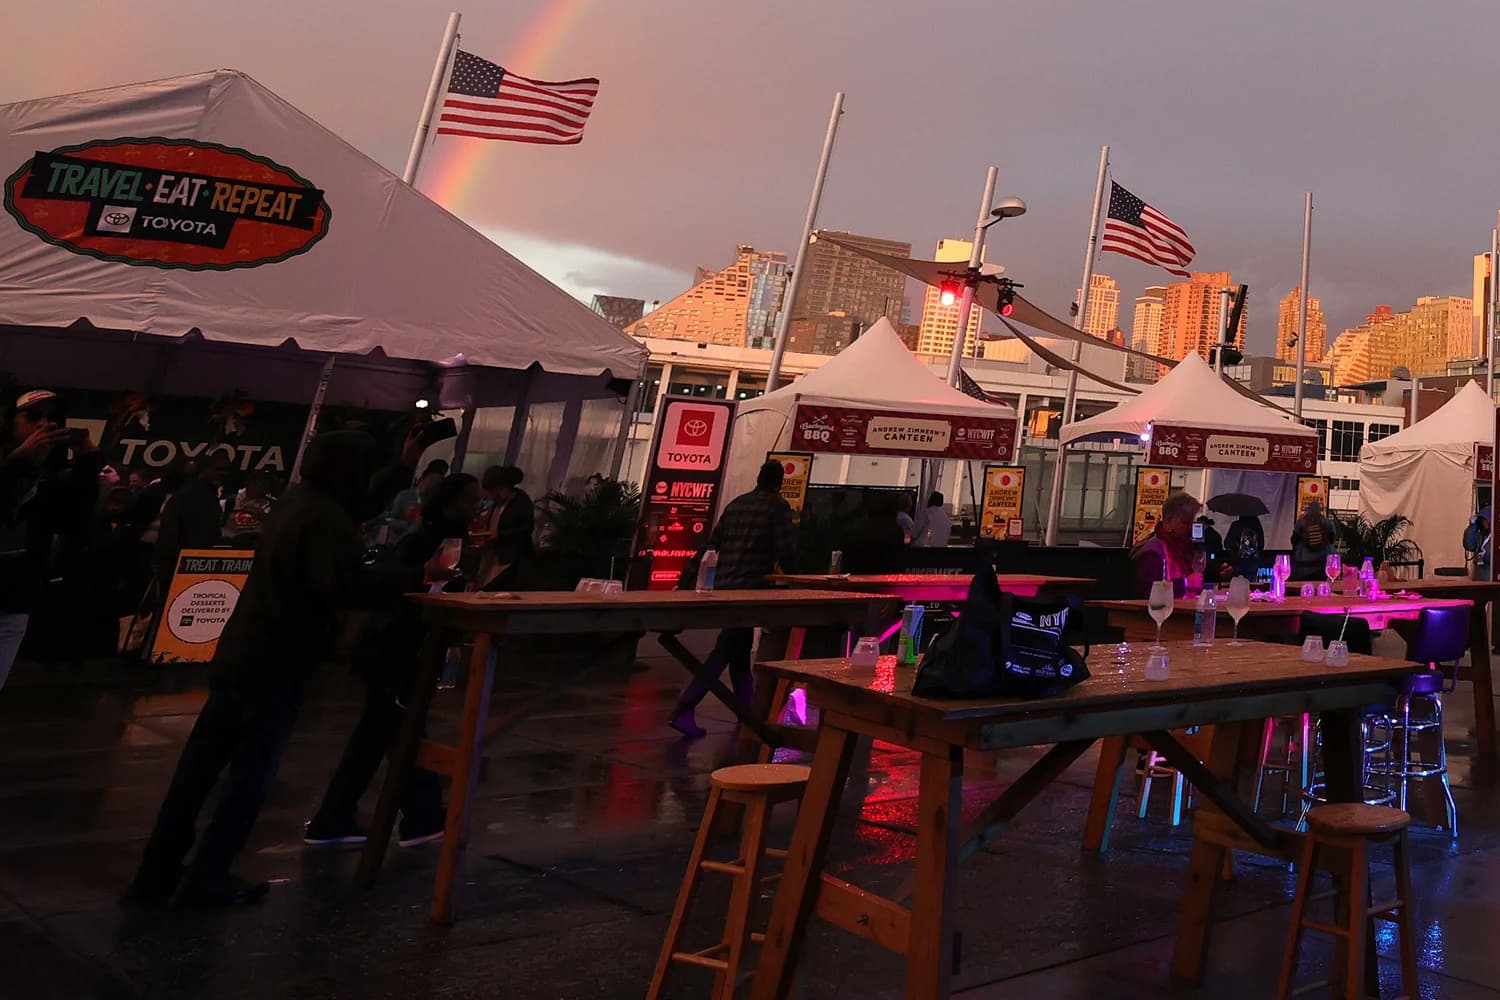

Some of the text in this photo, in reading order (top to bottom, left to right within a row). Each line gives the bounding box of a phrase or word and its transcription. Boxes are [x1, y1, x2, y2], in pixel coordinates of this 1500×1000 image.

[46, 161, 304, 222] TRAVEL EAT REPEAT
[141, 215, 218, 237] TOYOTA
[872, 426, 905, 434] ANDREW
[804, 430, 831, 443] BBQ
[884, 432, 934, 443] CANTEEN
[667, 452, 712, 464] TOYOTA
[1159, 446, 1179, 458] BBQ
[1218, 450, 1256, 458] CANTEEN
[671, 482, 715, 499] NYCWFF
[185, 559, 254, 572] TREAT TRAIN
